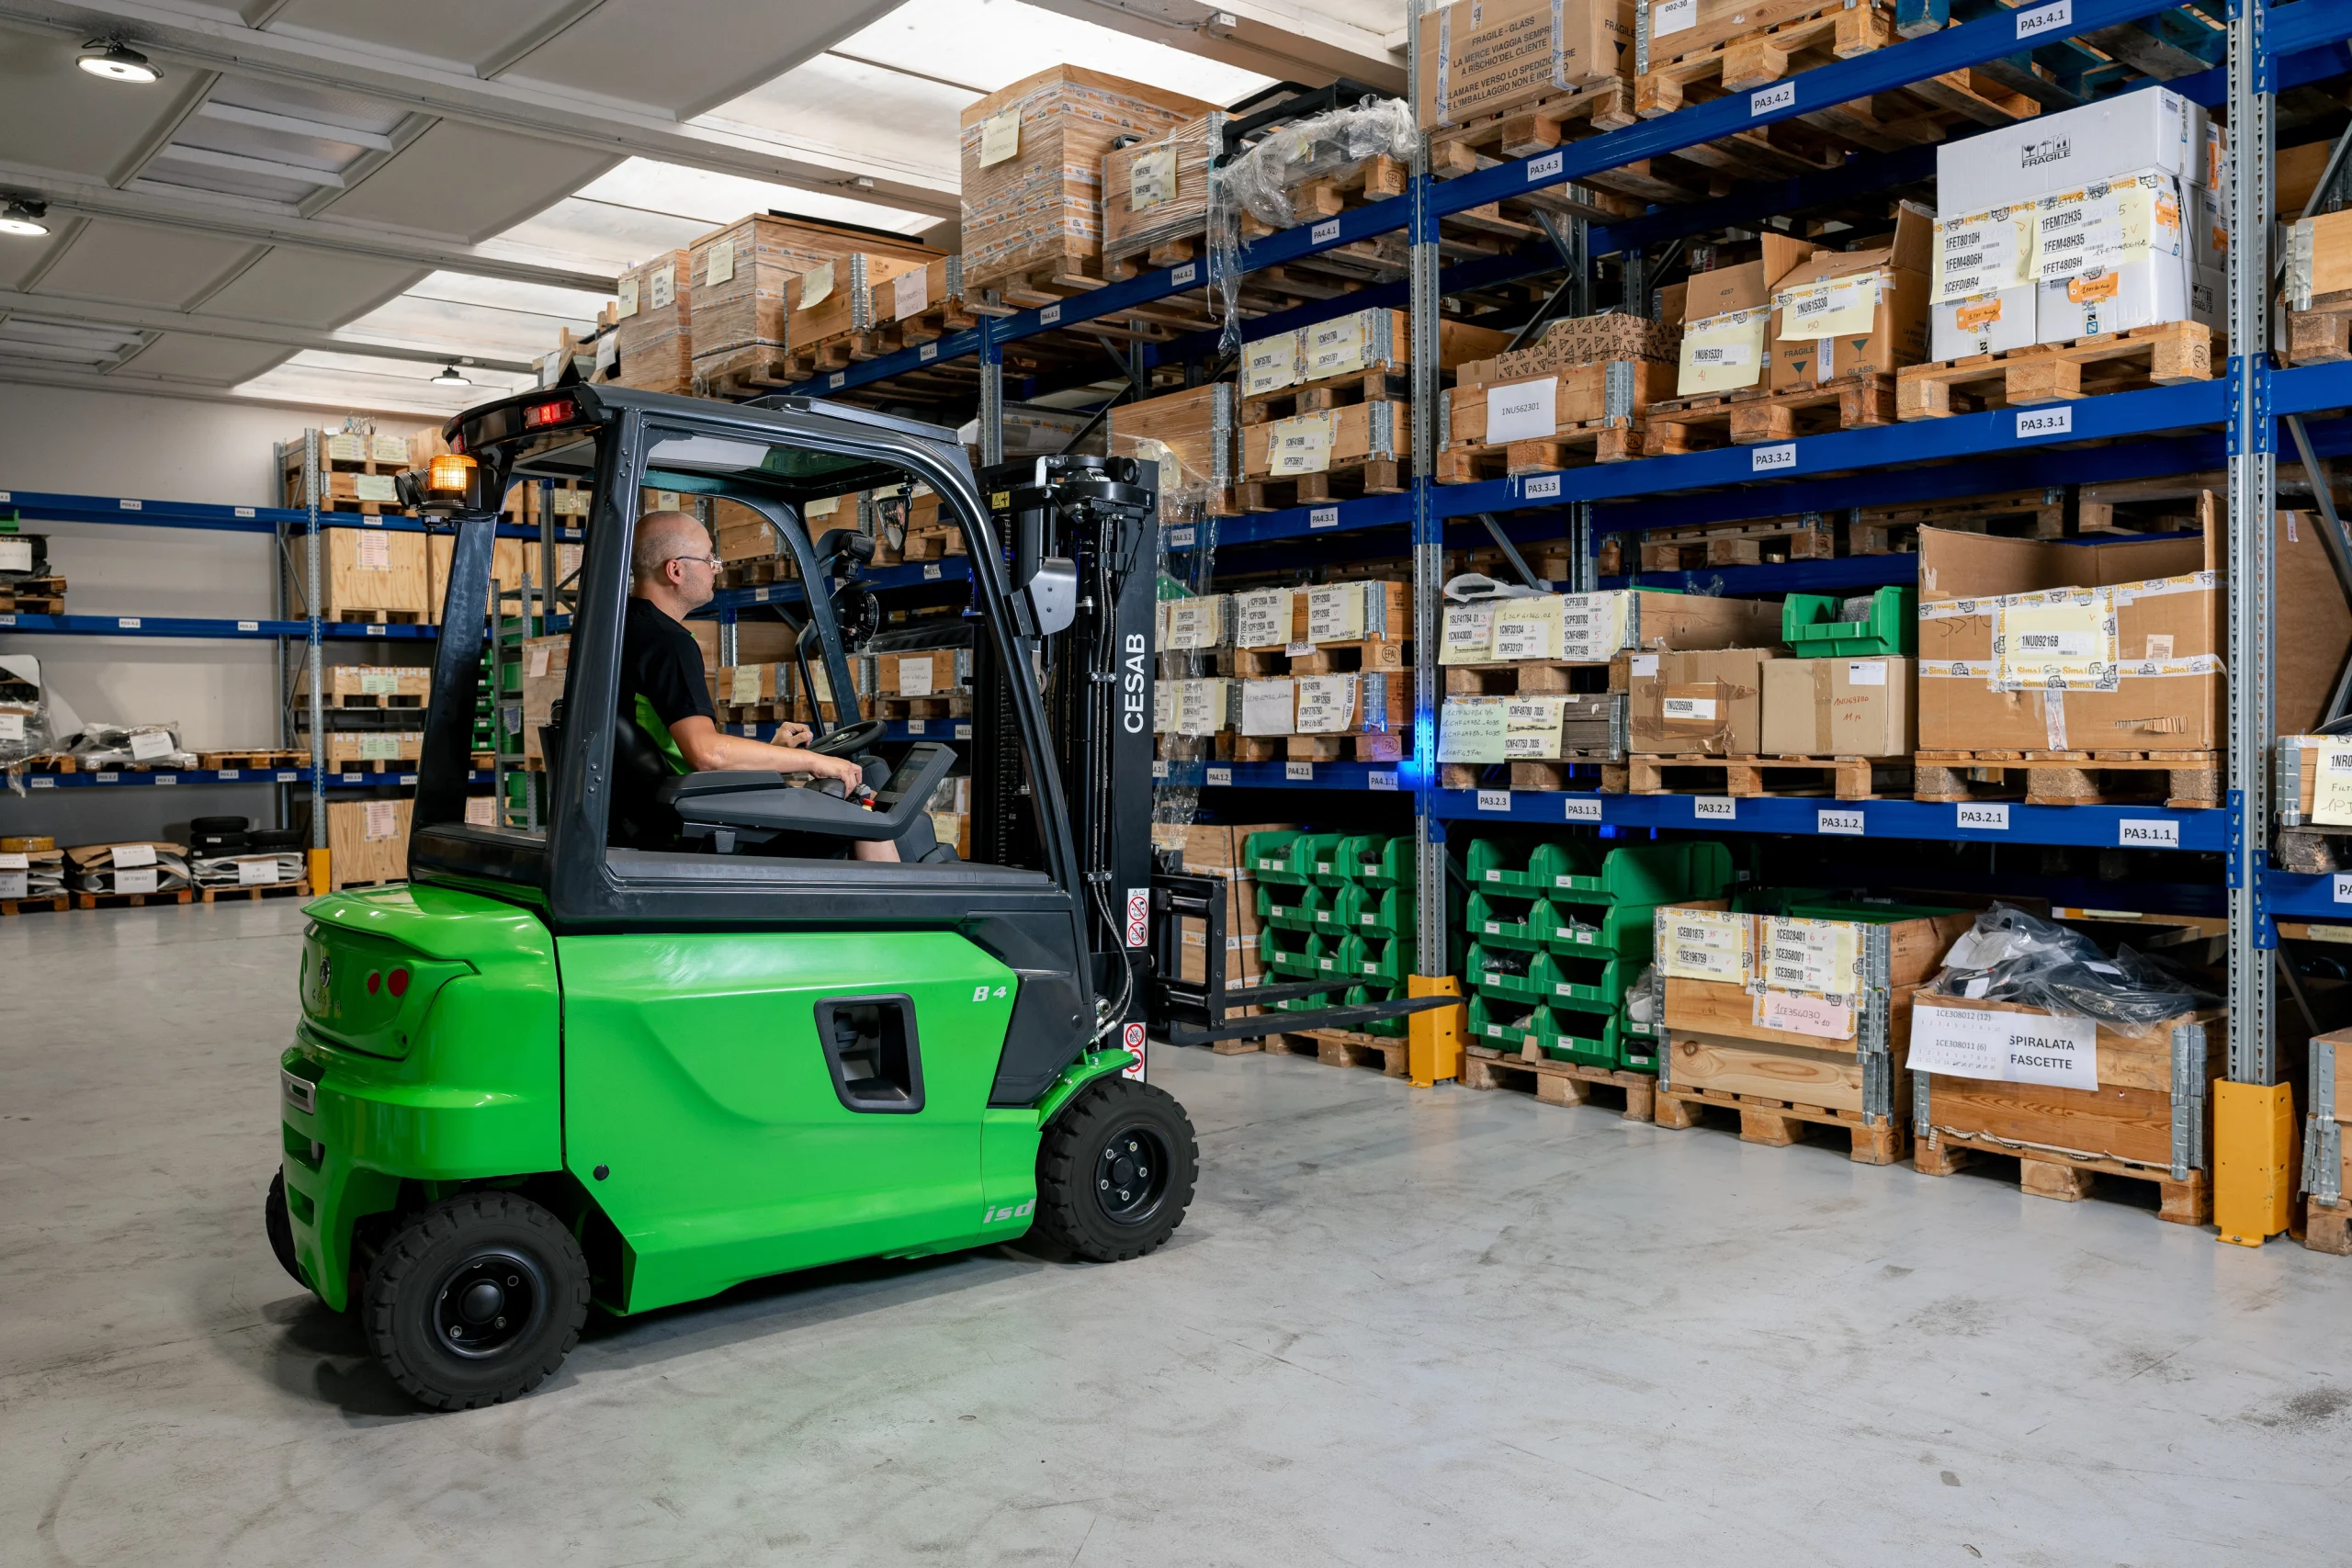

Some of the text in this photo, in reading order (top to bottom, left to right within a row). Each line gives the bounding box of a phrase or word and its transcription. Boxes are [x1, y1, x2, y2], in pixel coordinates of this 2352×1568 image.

[2021, 10, 2064, 31] PA3.4.1
[1472, 28, 1504, 46] FRAGILE
[1510, 17, 1535, 33] GLASS
[1604, 18, 1636, 39] FRAGILE
[1453, 58, 1463, 68] LA
[1464, 49, 1490, 64] MERCE
[1492, 37, 1522, 54] VIAGGIA
[1461, 38, 1547, 76] A RISCHIO DEL CLIENTE
[1481, 73, 1506, 87] VERSO
[1508, 68, 1518, 79] LO
[1453, 83, 1510, 108] L'IMBALLAGGIO
[1511, 76, 1529, 92] NON
[1536, 62, 1569, 81] INTAO
[1754, 91, 1790, 109] PA3.4.2
[2022, 151, 2071, 168] FRAGILE
[1530, 160, 1559, 175] PA3.4.3
[2041, 209, 2082, 231] 1FEM72H35
[1314, 226, 1336, 240] PA4.4.1
[1945, 231, 1980, 249] 1FET8010H
[2044, 233, 2085, 252] 1FEM48H35
[1946, 253, 1983, 270] 1FEM4806H
[2043, 256, 2083, 275] 1FET4809H
[1173, 270, 1193, 281] PA4.4.2
[1797, 297, 1828, 315] 1NU615330
[1042, 310, 1058, 321] PA4.4.3
[1694, 348, 1723, 360] 1NU615331
[1784, 345, 1815, 358] FRAGILE
[1848, 365, 1874, 376] GLASS
[1502, 402, 1540, 416] 1NU562301
[2021, 416, 2064, 432] PA3.3.1
[1756, 452, 1791, 466] PA3.3.2
[1528, 482, 1556, 494] PA3.3.3
[1312, 513, 1335, 523] PA4.3.1
[2021, 635, 2059, 647] 1NU09216B
[1928, 666, 1951, 675] Simai
[2018, 667, 2041, 675] Simai
[2063, 667, 2087, 675] Simai
[2162, 665, 2189, 674] Simai
[1124, 634, 1145, 733] CESAB
[2023, 680, 2046, 688] Simai
[2069, 680, 2094, 689] Simai
[1666, 700, 1693, 712] 1NU205009
[1480, 796, 1507, 806] PA3.2.3
[1698, 803, 1731, 814] PA3.2.2
[1961, 811, 2002, 823] PA3.2.1
[1678, 927, 1704, 939] 1CE001875
[1936, 1010, 1991, 1021] 1CE308012 (12)
[1935, 1039, 1987, 1052] 1CE308011 (6)
[2009, 1035, 2075, 1051] SPIRALATA
[2010, 1055, 2073, 1069] FASCETTE
[983, 1199, 1036, 1224] isd
